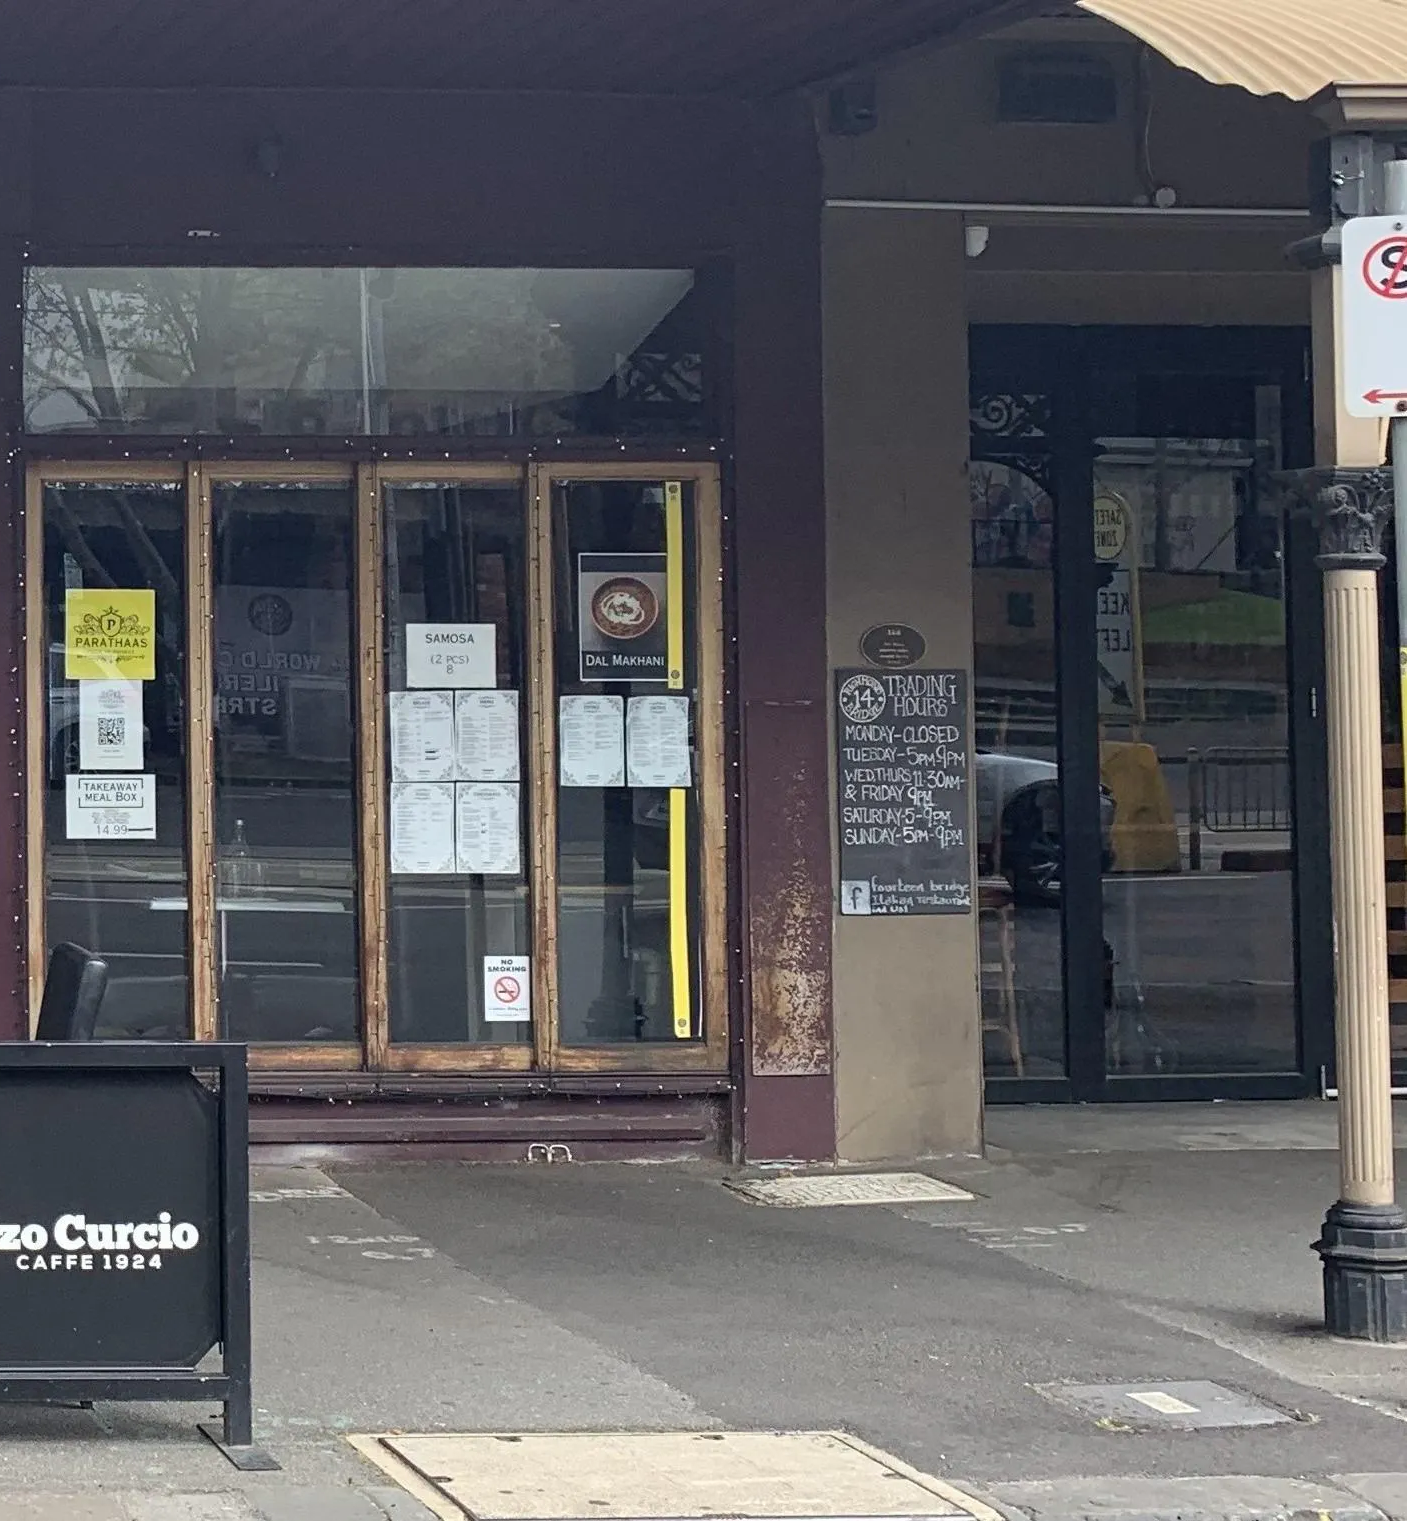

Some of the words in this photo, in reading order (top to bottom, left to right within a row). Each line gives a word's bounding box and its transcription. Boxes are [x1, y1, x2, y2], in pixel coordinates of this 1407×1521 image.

[75, 637, 148, 648] PARATHAAS
[425, 633, 475, 645] SAMOSA
[585, 654, 609, 666] DAL
[612, 654, 665, 666] MAKHANI
[882, 675, 957, 704] TRADING
[853, 688, 875, 708] 14
[894, 696, 948, 717] HOURS
[84, 782, 138, 792] TAKEAWAY
[845, 784, 857, 802] &
[85, 792, 112, 802] MEAL
[54, 1211, 200, 1251] Curcio
[16, 1254, 94, 1270] CAFFE
[103, 1254, 162, 1270] 1924
